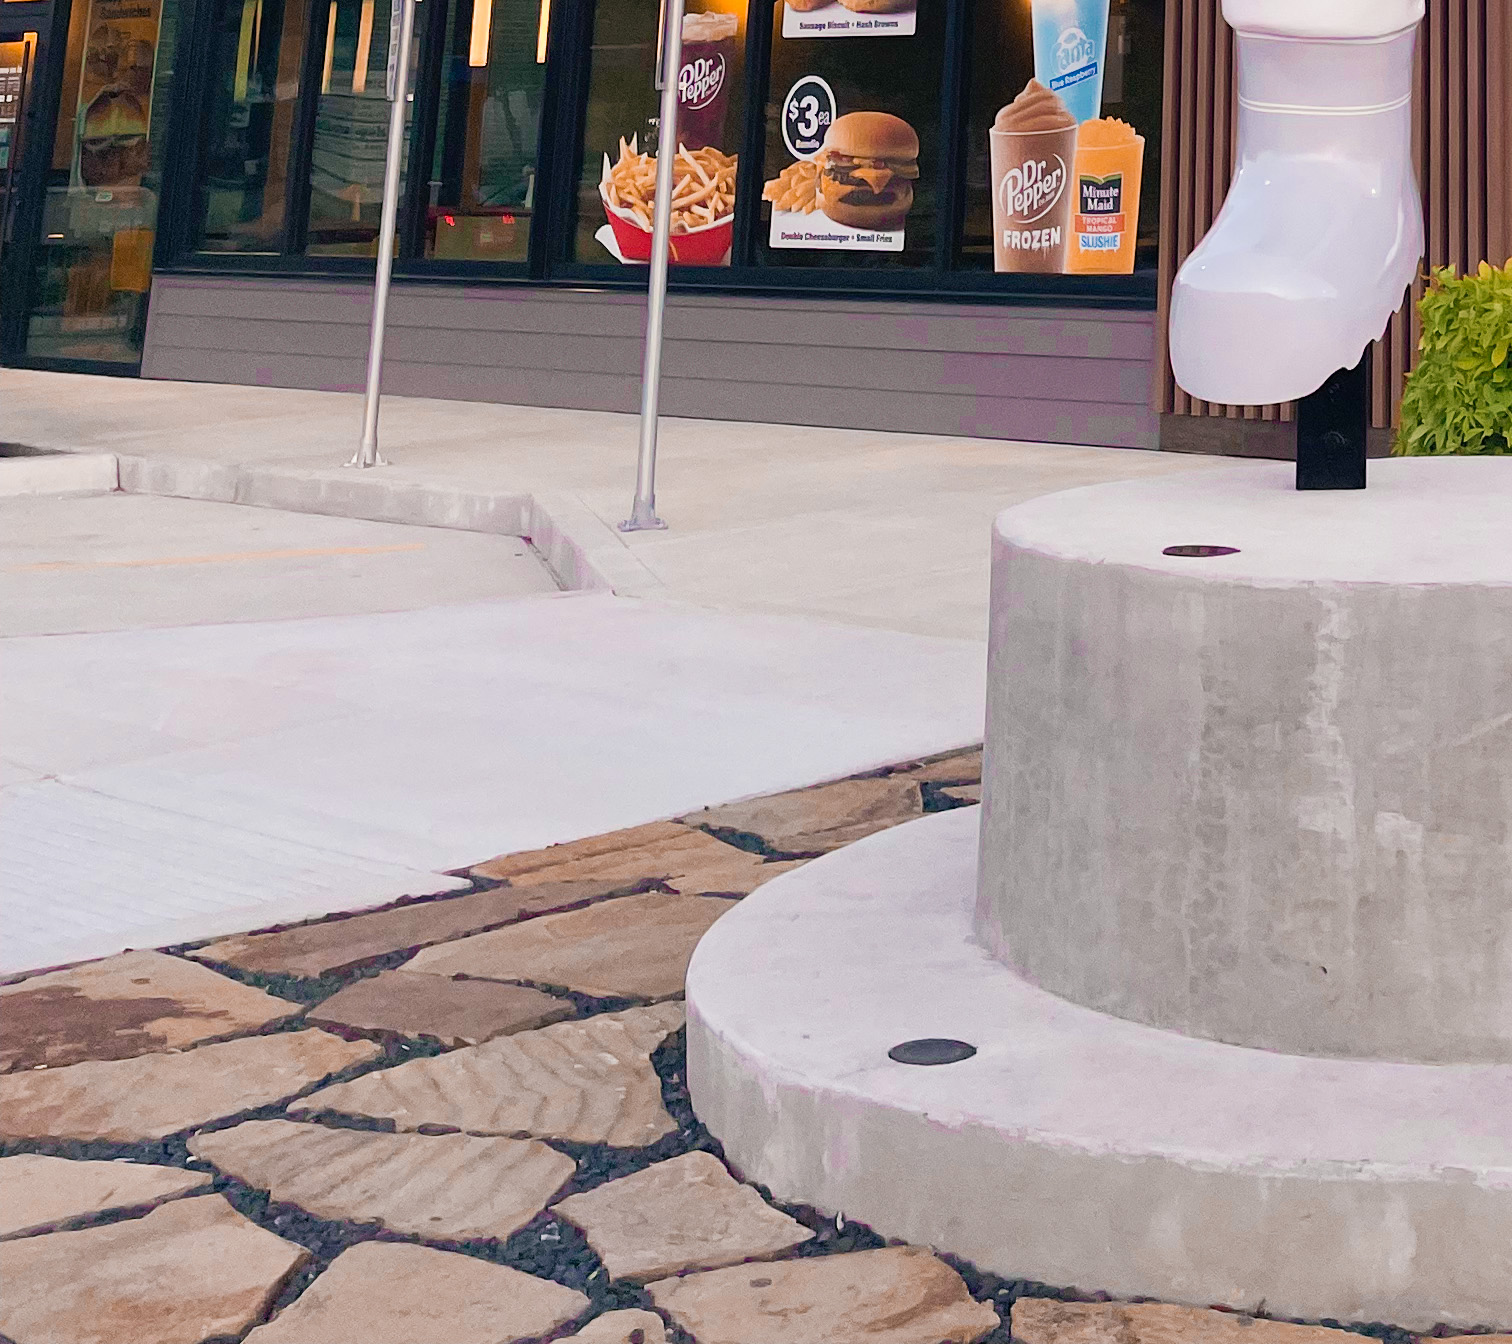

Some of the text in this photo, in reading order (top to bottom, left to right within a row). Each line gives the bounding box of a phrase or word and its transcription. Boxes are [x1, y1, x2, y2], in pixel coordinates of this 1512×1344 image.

[694, 58, 714, 83] Dr
[678, 63, 723, 104] Pepper
[1000, 159, 1062, 217] Dr Pepper
[1082, 184, 1120, 199] Minute
[1087, 197, 1114, 211] Maid
[1082, 216, 1118, 225] TROPICAL
[856, 233, 875, 243] Small
[1003, 225, 1061, 250] FROZEN
[1081, 234, 1119, 248] SLUSHIE
